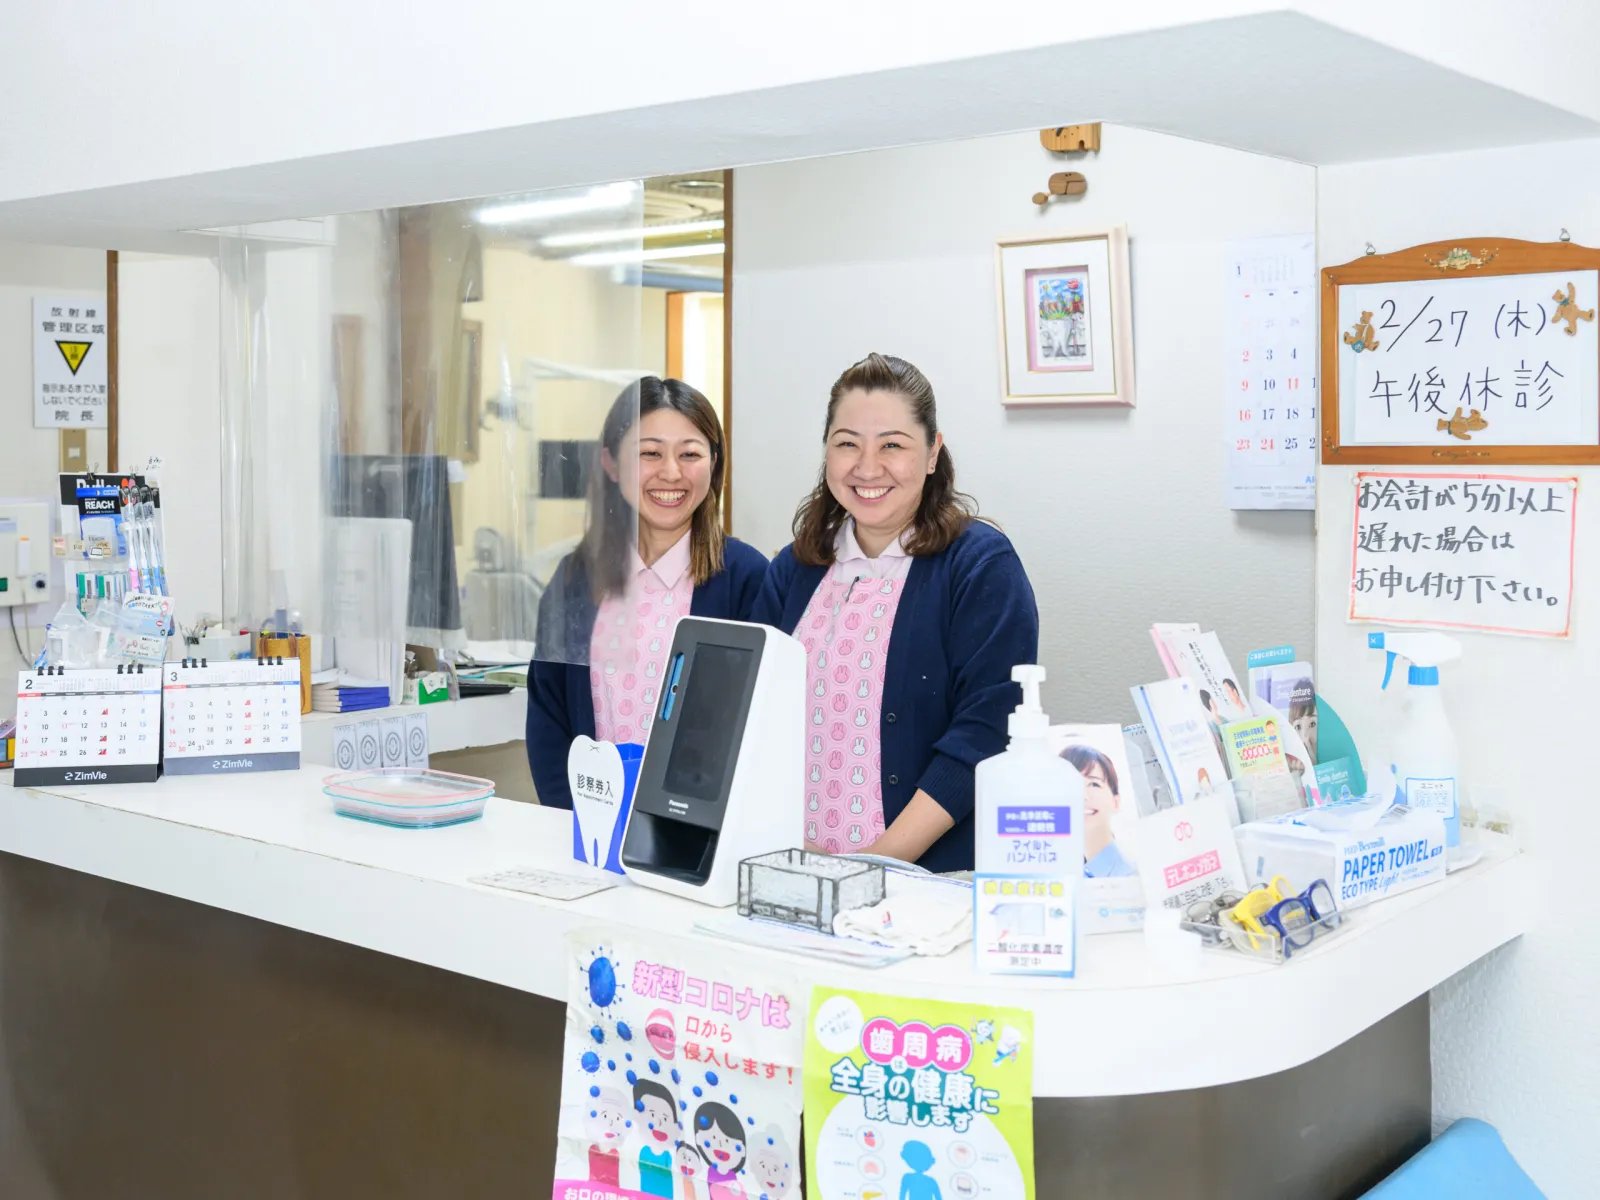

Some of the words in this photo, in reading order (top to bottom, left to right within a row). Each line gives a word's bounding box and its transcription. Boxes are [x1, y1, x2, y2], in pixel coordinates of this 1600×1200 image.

[51, 307, 97, 318] 放射線
[1379, 296, 1468, 352] 2/27
[1494, 299, 1546, 339] (木)
[42, 321, 105, 334] 管理区域
[1242, 350, 1249, 362] 2
[1266, 348, 1273, 360] 3
[1290, 347, 1297, 359] 4
[1241, 380, 1249, 391] 9
[1263, 379, 1276, 391] 10
[1287, 377, 1299, 390] 11
[1369, 359, 1564, 418] 午後休診
[1238, 409, 1251, 421] 16
[1262, 408, 1275, 420] 17
[1286, 407, 1299, 420] 18
[1236, 439, 1251, 451] 23
[1260, 438, 1274, 450] 24
[1285, 437, 1298, 450] 25
[84, 500, 115, 510] REACH
[1357, 479, 1565, 515] お会計が5分以上
[1357, 522, 1515, 554] 遅れた場合は
[1354, 565, 1558, 606] お申し付け下さい。
[25, 679, 33, 690] 2
[170, 672, 178, 682] 3
[1289, 687, 1311, 697] denture
[74, 771, 107, 781] ZimVie
[222, 759, 253, 769] ZimVie
[577, 773, 614, 798] 診察券入
[1342, 850, 1386, 884] PAPER
[1388, 838, 1429, 871] TOWEL
[1341, 881, 1358, 901] ECO
[1359, 877, 1379, 896] TYPE
[1378, 871, 1400, 894] Light
[632, 960, 791, 1029] 新型コロナは
[686, 1015, 733, 1044] 口から
[869, 1027, 964, 1064] 歯周病
[683, 1041, 794, 1085] 侵入します！
[830, 1056, 1000, 1115] 全身の健康に
[864, 1096, 974, 1134] 影響します
